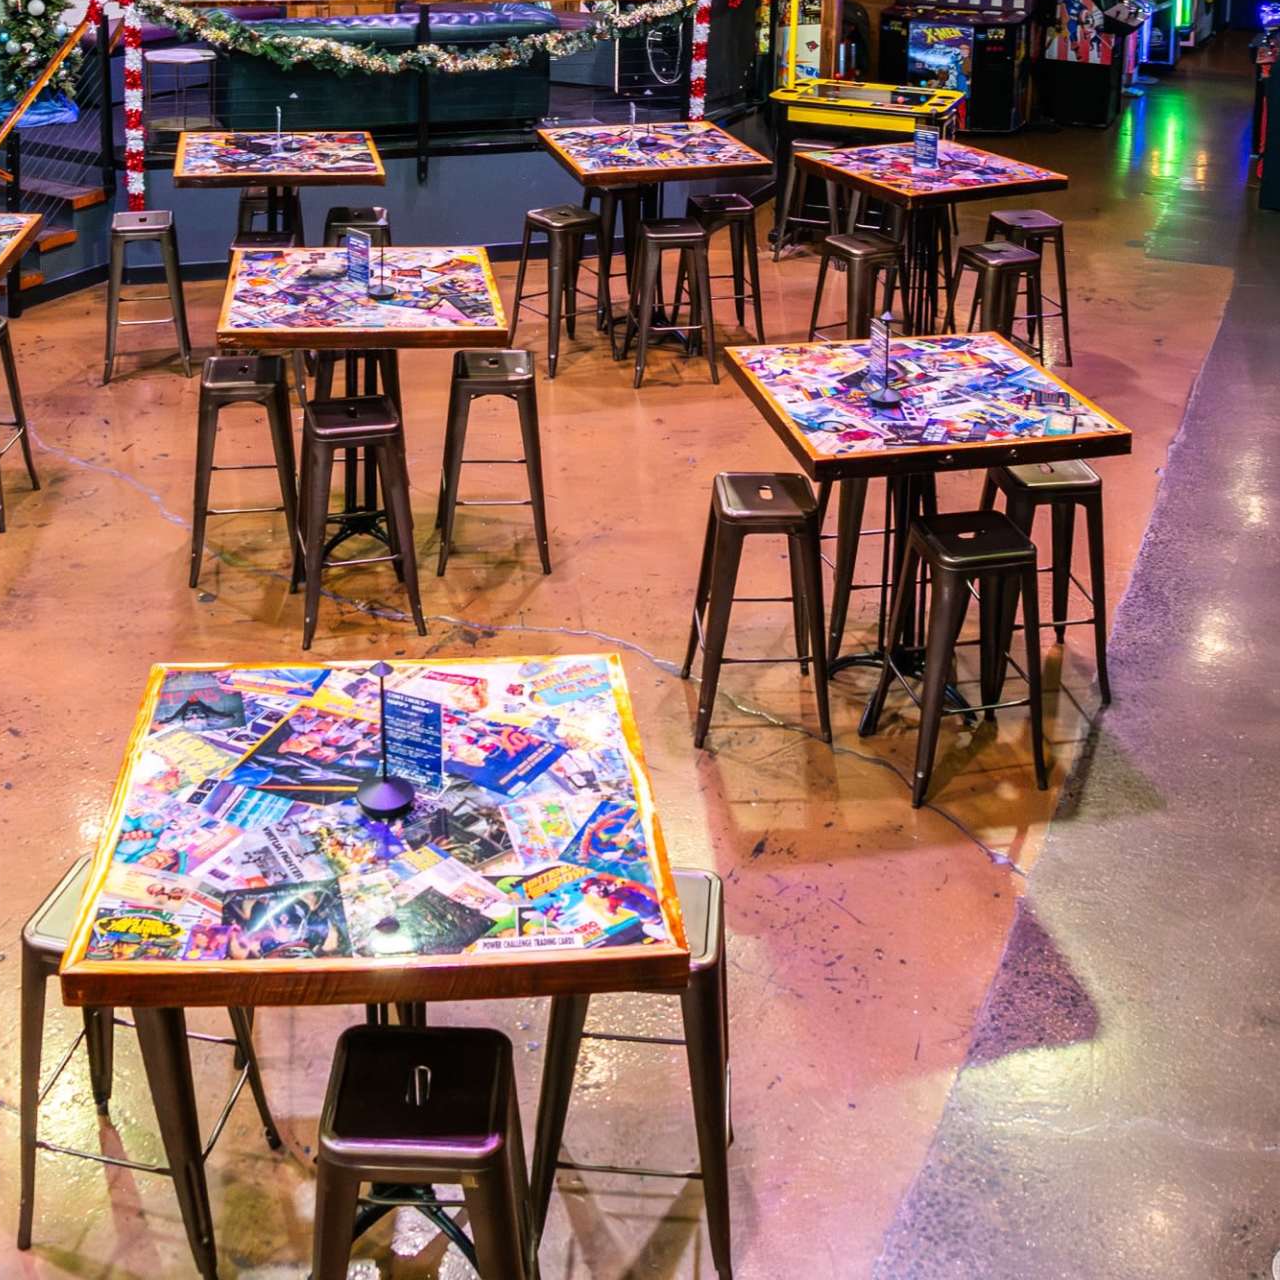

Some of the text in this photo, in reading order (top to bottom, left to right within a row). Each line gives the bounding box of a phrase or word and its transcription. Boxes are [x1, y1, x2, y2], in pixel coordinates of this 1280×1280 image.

[923, 27, 963, 44] X-MEN
[262, 826, 306, 880] VIRTUA FIGHTER
[482, 935, 575, 949] POWER CHALLENGE TRADING CARDS
